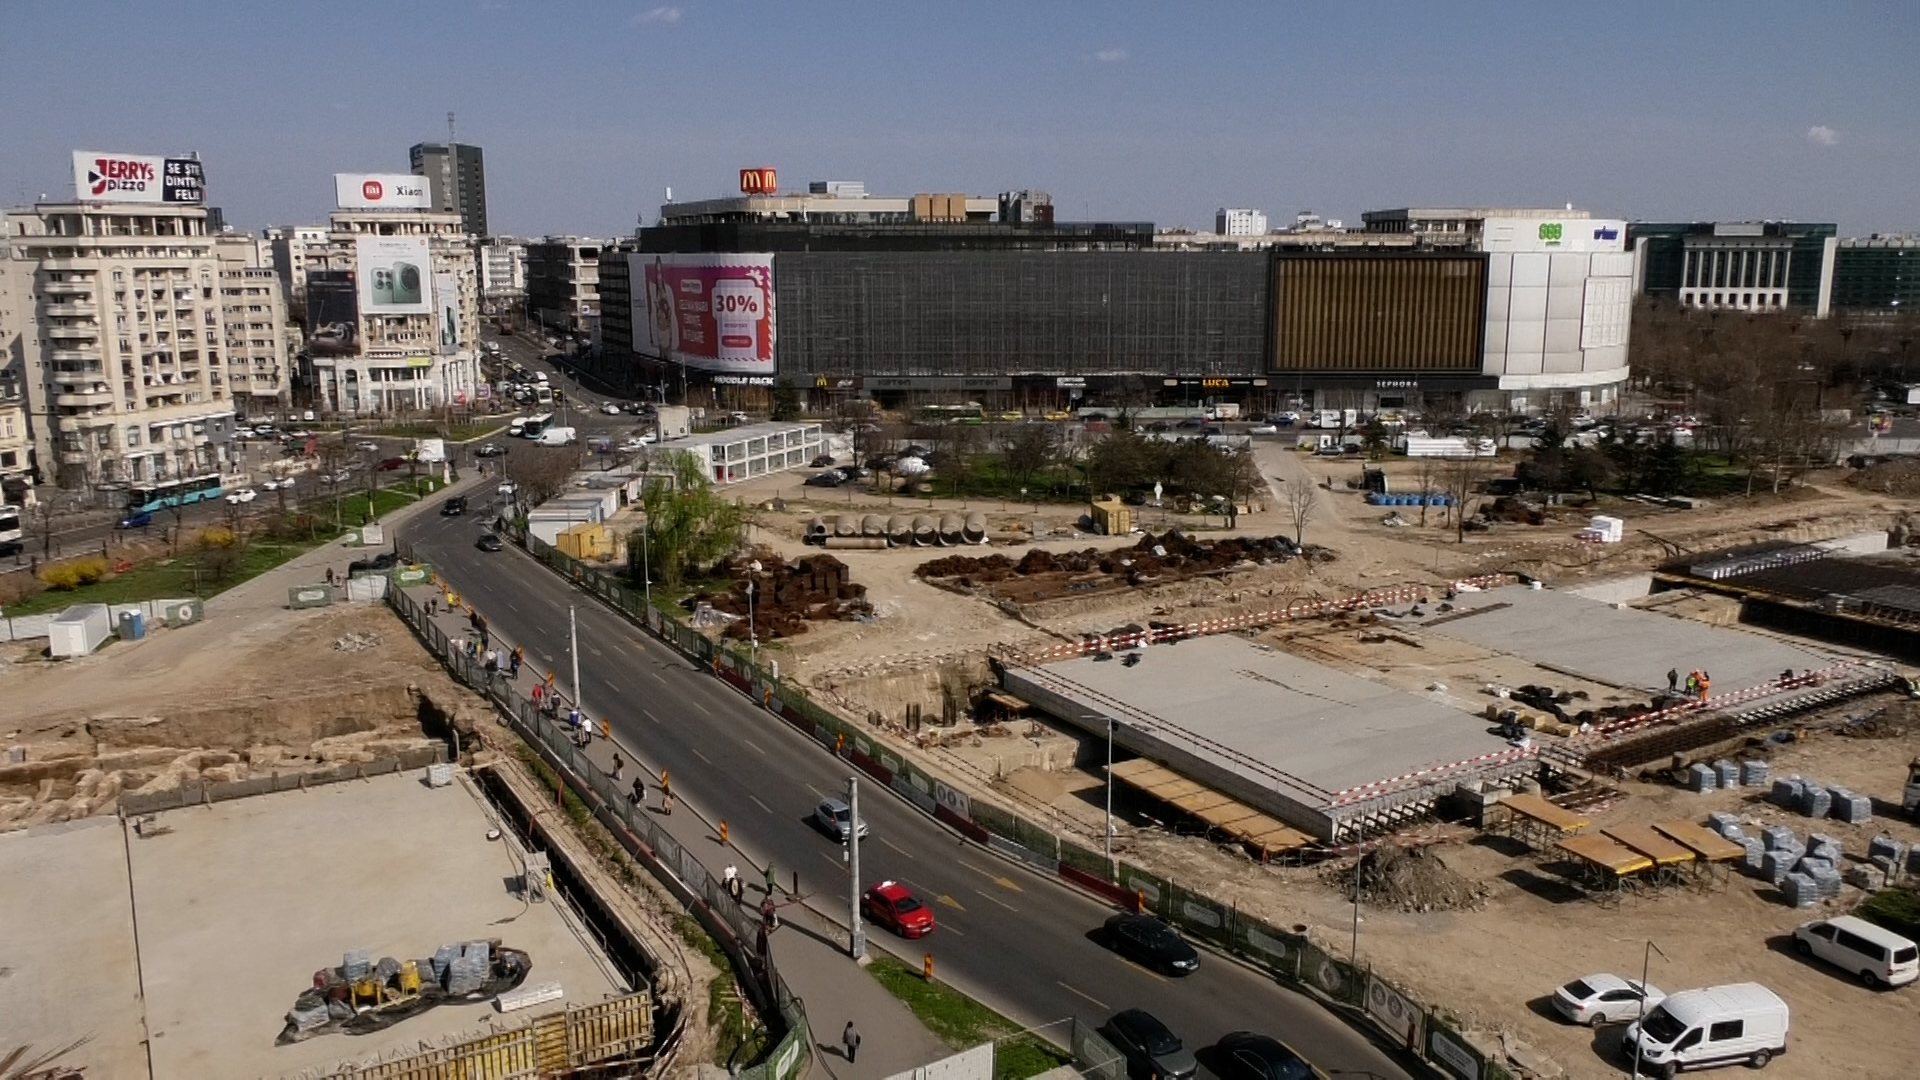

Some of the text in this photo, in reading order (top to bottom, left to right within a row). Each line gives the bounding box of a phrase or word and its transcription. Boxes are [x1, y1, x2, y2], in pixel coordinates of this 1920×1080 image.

[167, 163, 181, 174] SE
[715, 294, 758, 313] 30%
[1202, 379, 1229, 388] LUCA
